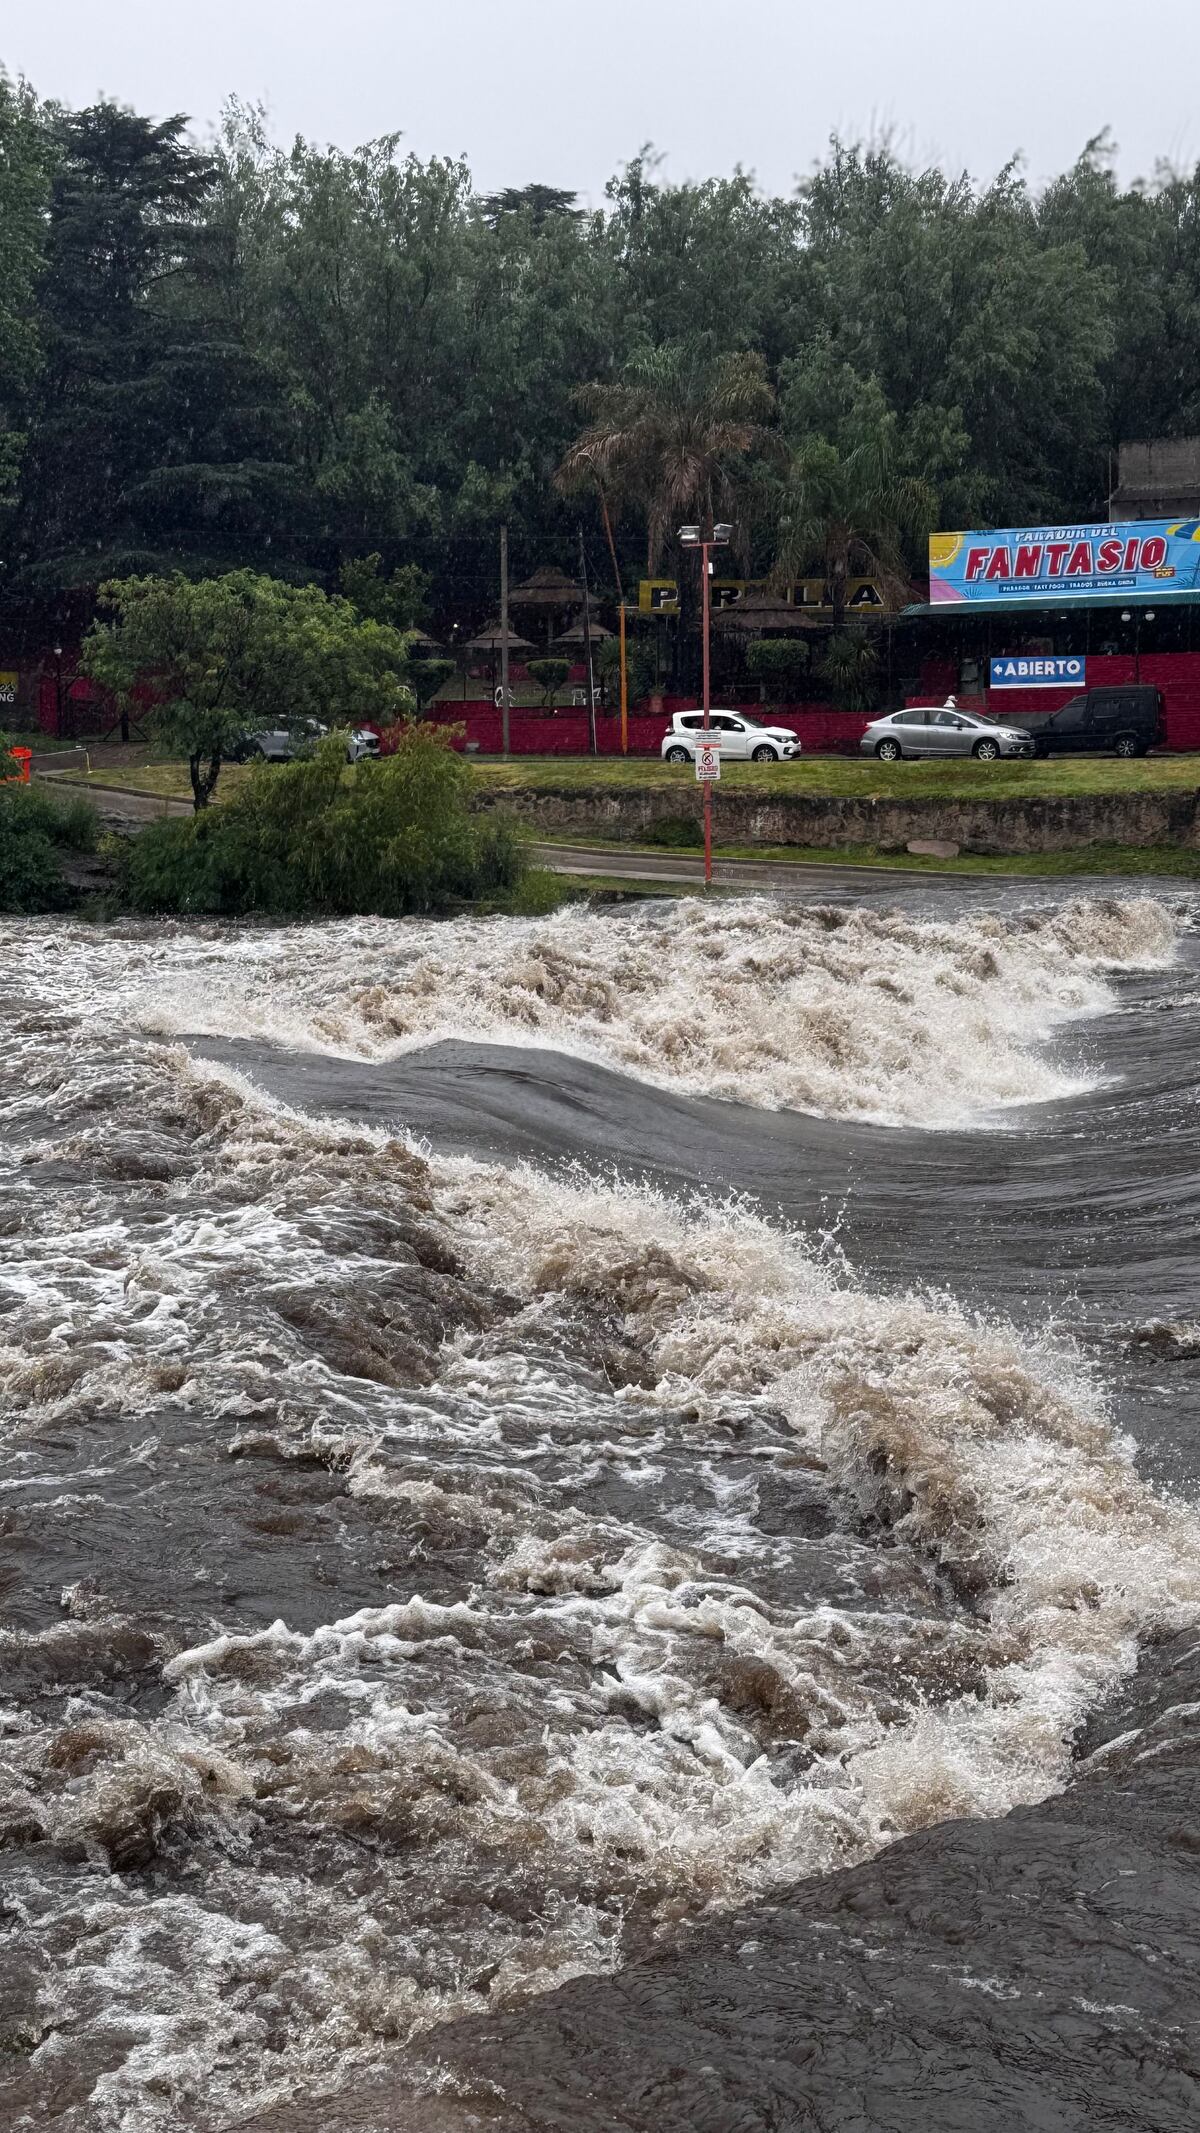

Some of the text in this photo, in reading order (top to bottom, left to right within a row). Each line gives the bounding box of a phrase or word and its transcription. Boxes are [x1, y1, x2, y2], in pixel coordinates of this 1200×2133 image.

[1091, 526, 1119, 538] DEL
[964, 536, 1167, 582] FANTASIO
[1004, 660, 1081, 676] ABIERTO
